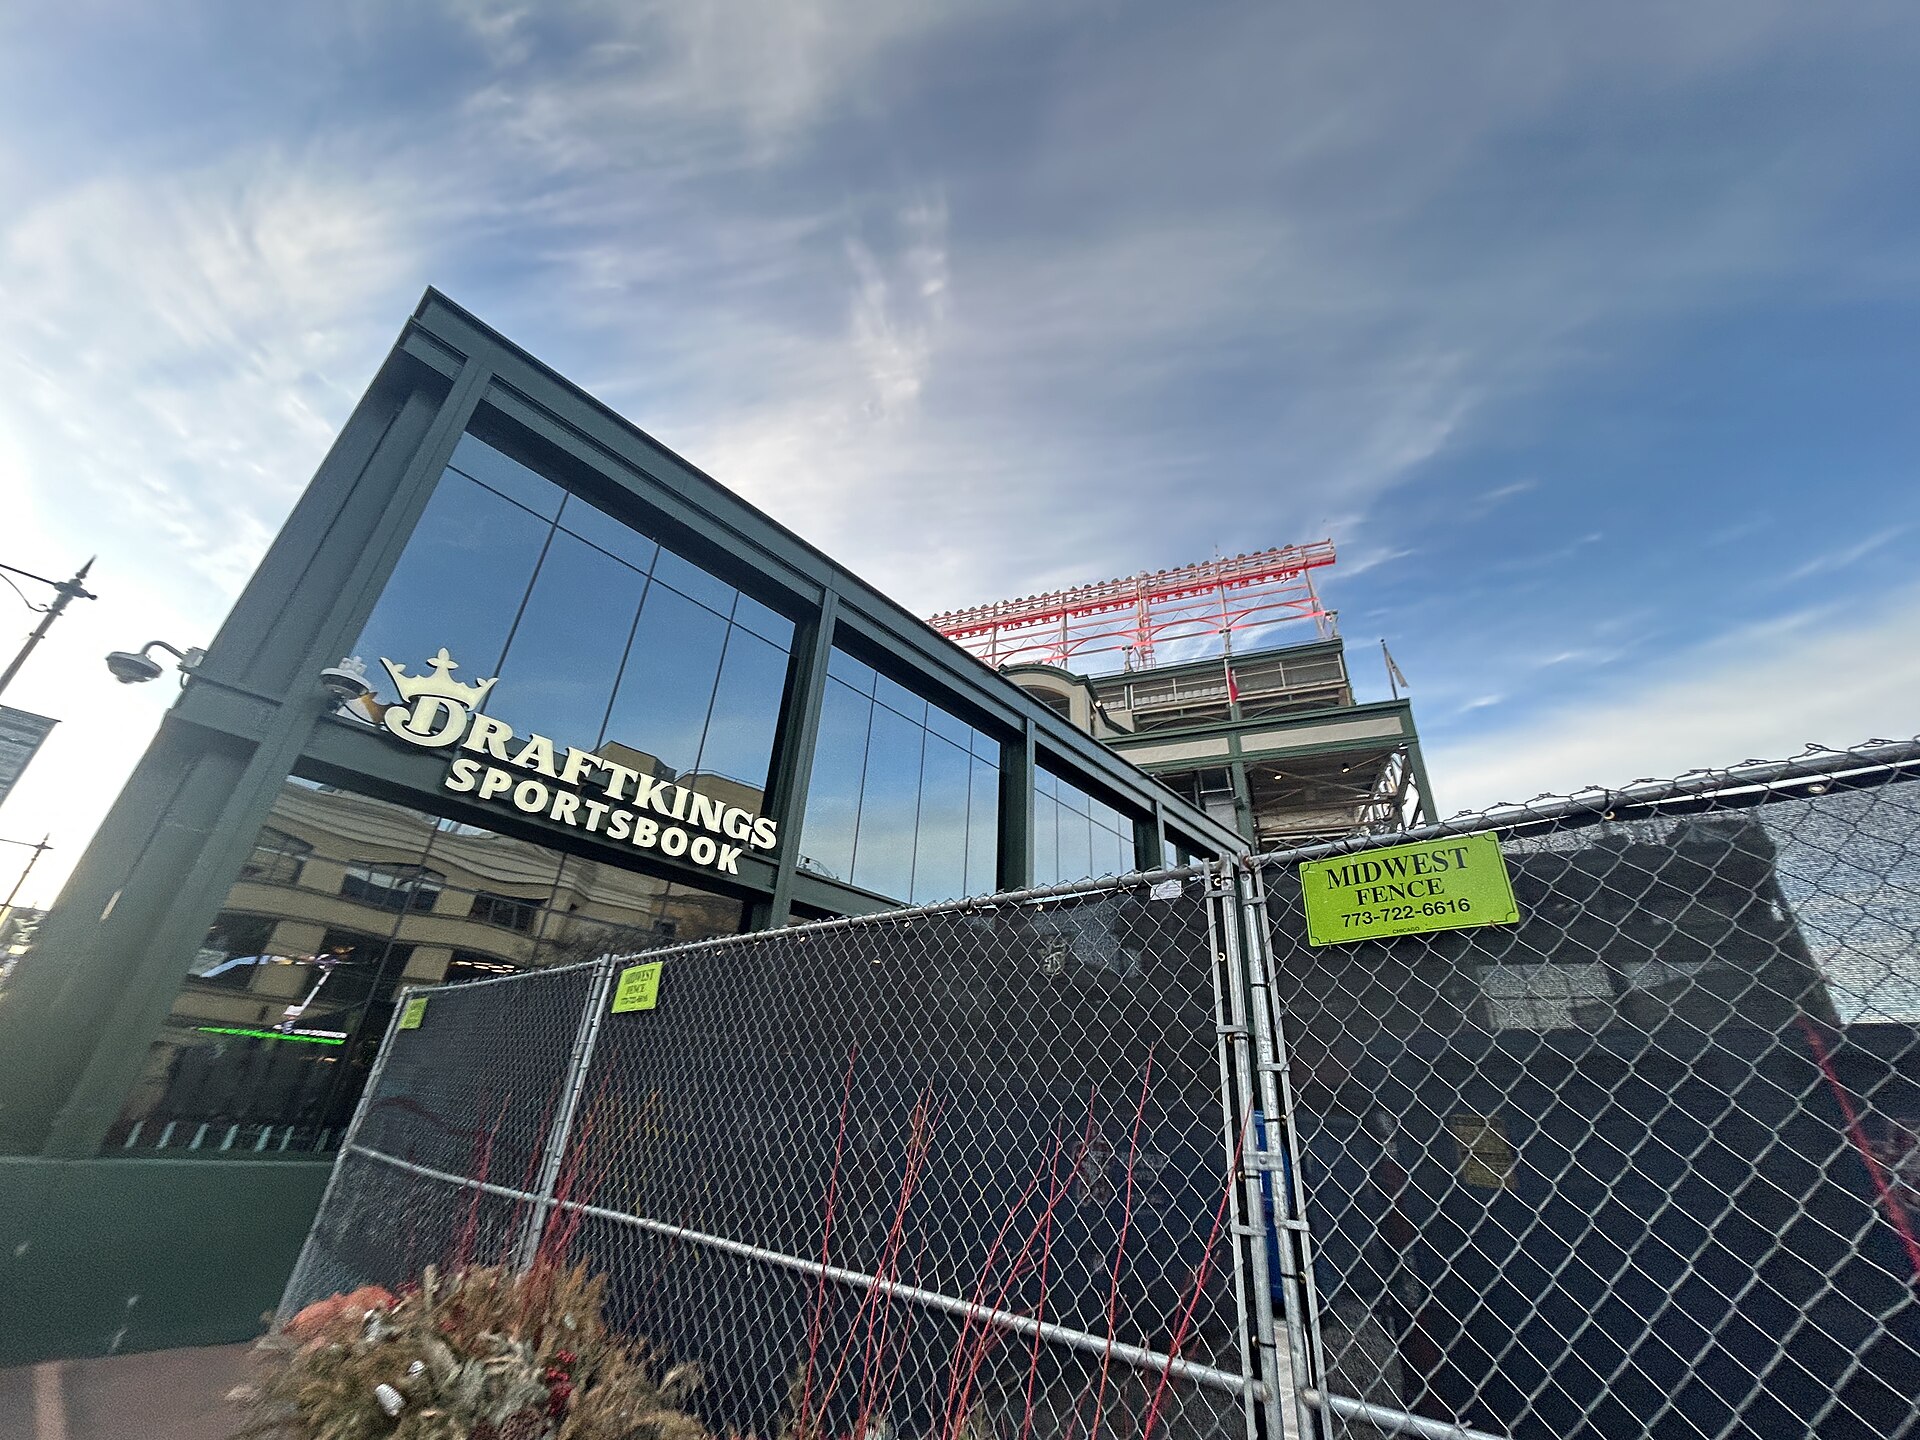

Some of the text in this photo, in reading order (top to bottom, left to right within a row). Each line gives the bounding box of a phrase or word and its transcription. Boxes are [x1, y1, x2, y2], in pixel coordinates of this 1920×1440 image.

[384, 694, 777, 850] DRAFTKINGS
[445, 758, 743, 875] SPORTSBOOK
[1325, 847, 1469, 889] MIDWEST
[1355, 877, 1444, 905] FENCE
[1341, 898, 1470, 927] 773-722-6616
[1392, 926, 1420, 934] CHICAGO
